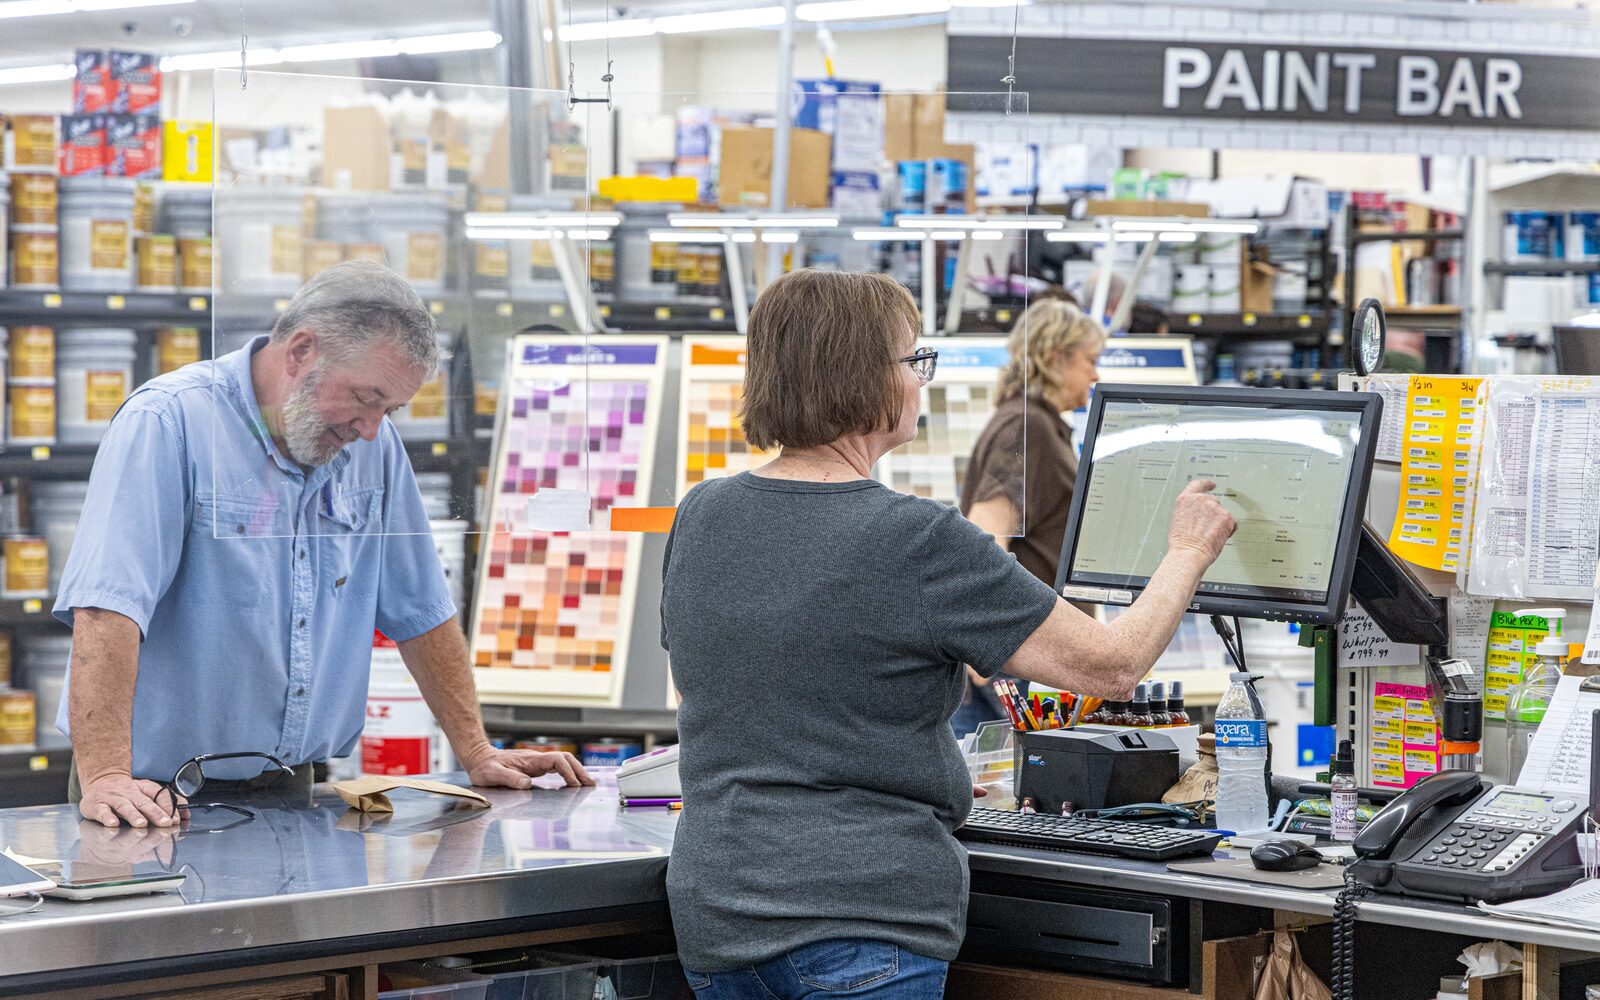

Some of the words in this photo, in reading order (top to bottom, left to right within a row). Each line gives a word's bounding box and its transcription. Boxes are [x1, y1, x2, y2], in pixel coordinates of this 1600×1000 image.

[1163, 47, 1376, 114] PAINT
[1397, 55, 1523, 119] BAR
[1461, 381, 1474, 392] 3/4
[1498, 614, 1515, 625] Blue
[1520, 616, 1533, 625] Pex
[1537, 617, 1547, 625] Pi
[366, 705, 390, 718] LZ
